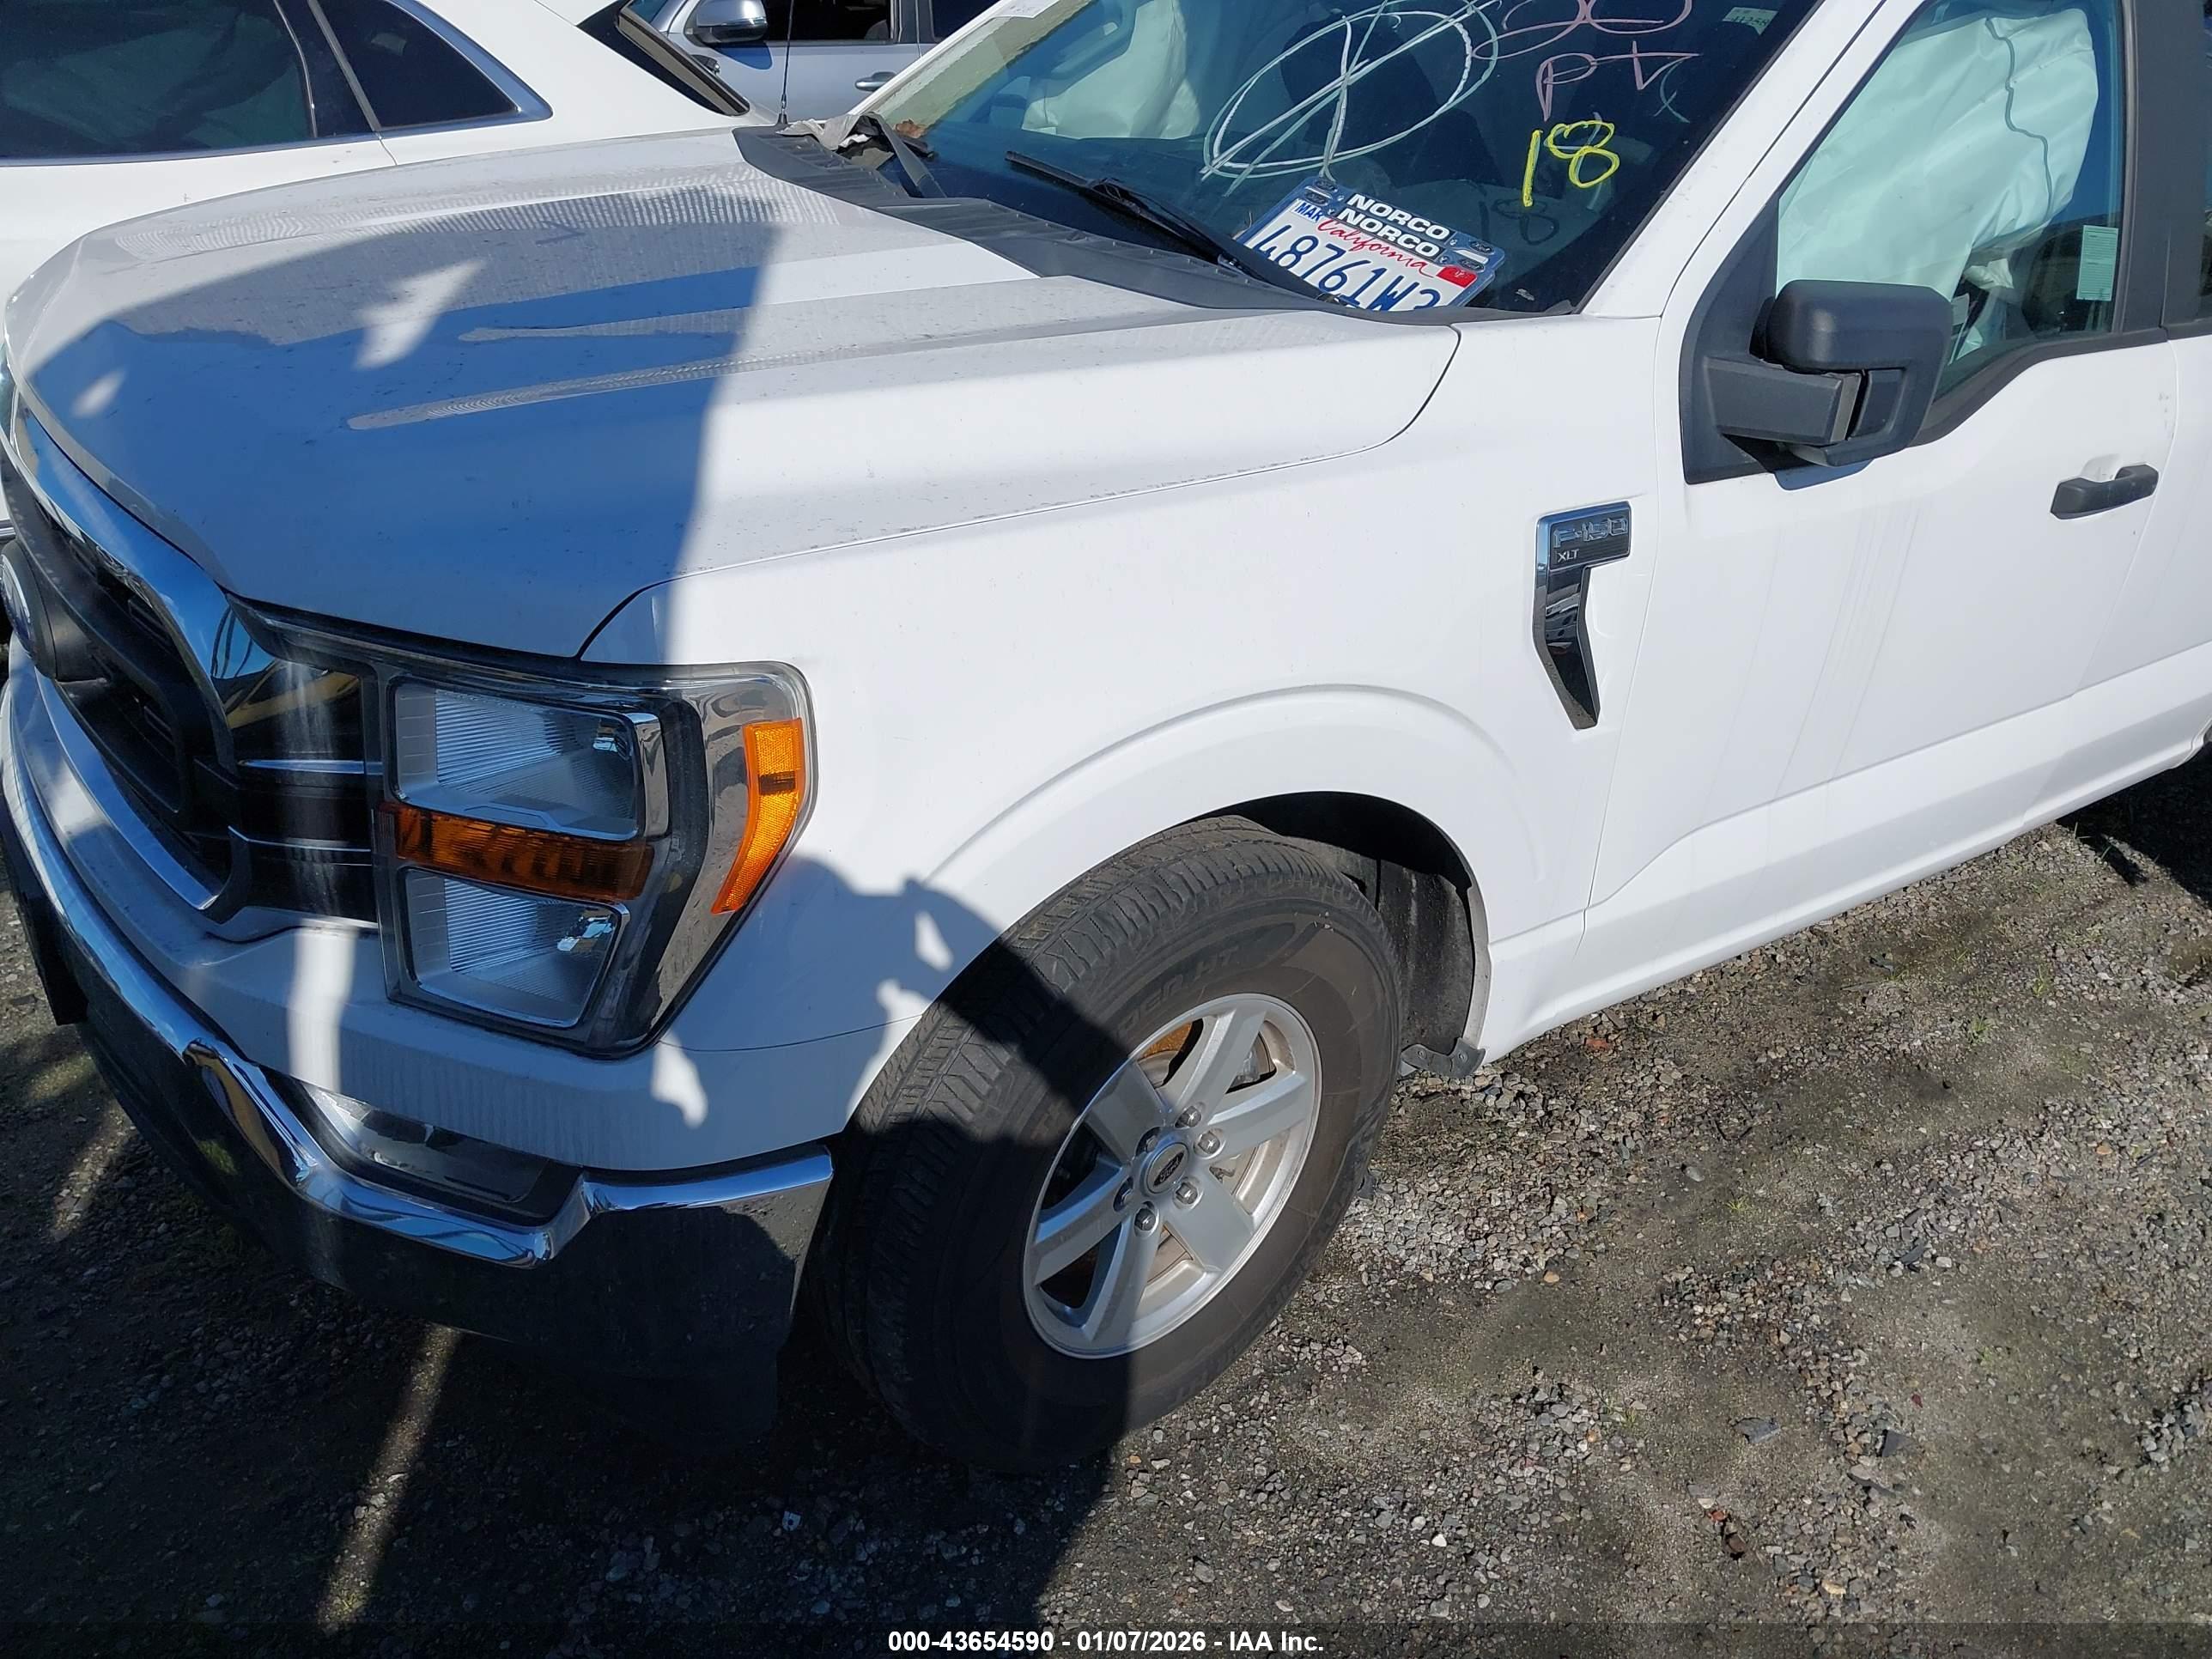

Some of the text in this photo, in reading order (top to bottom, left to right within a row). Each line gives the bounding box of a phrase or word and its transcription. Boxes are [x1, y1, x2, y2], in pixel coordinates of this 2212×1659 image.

[1522, 119, 1620, 208] 18
[1337, 208, 1440, 257] NORCO
[1346, 193, 1450, 240] NORCO
[1317, 216, 1434, 278] California
[1553, 518, 1629, 548] F-150
[1558, 549, 1579, 562] XLT
